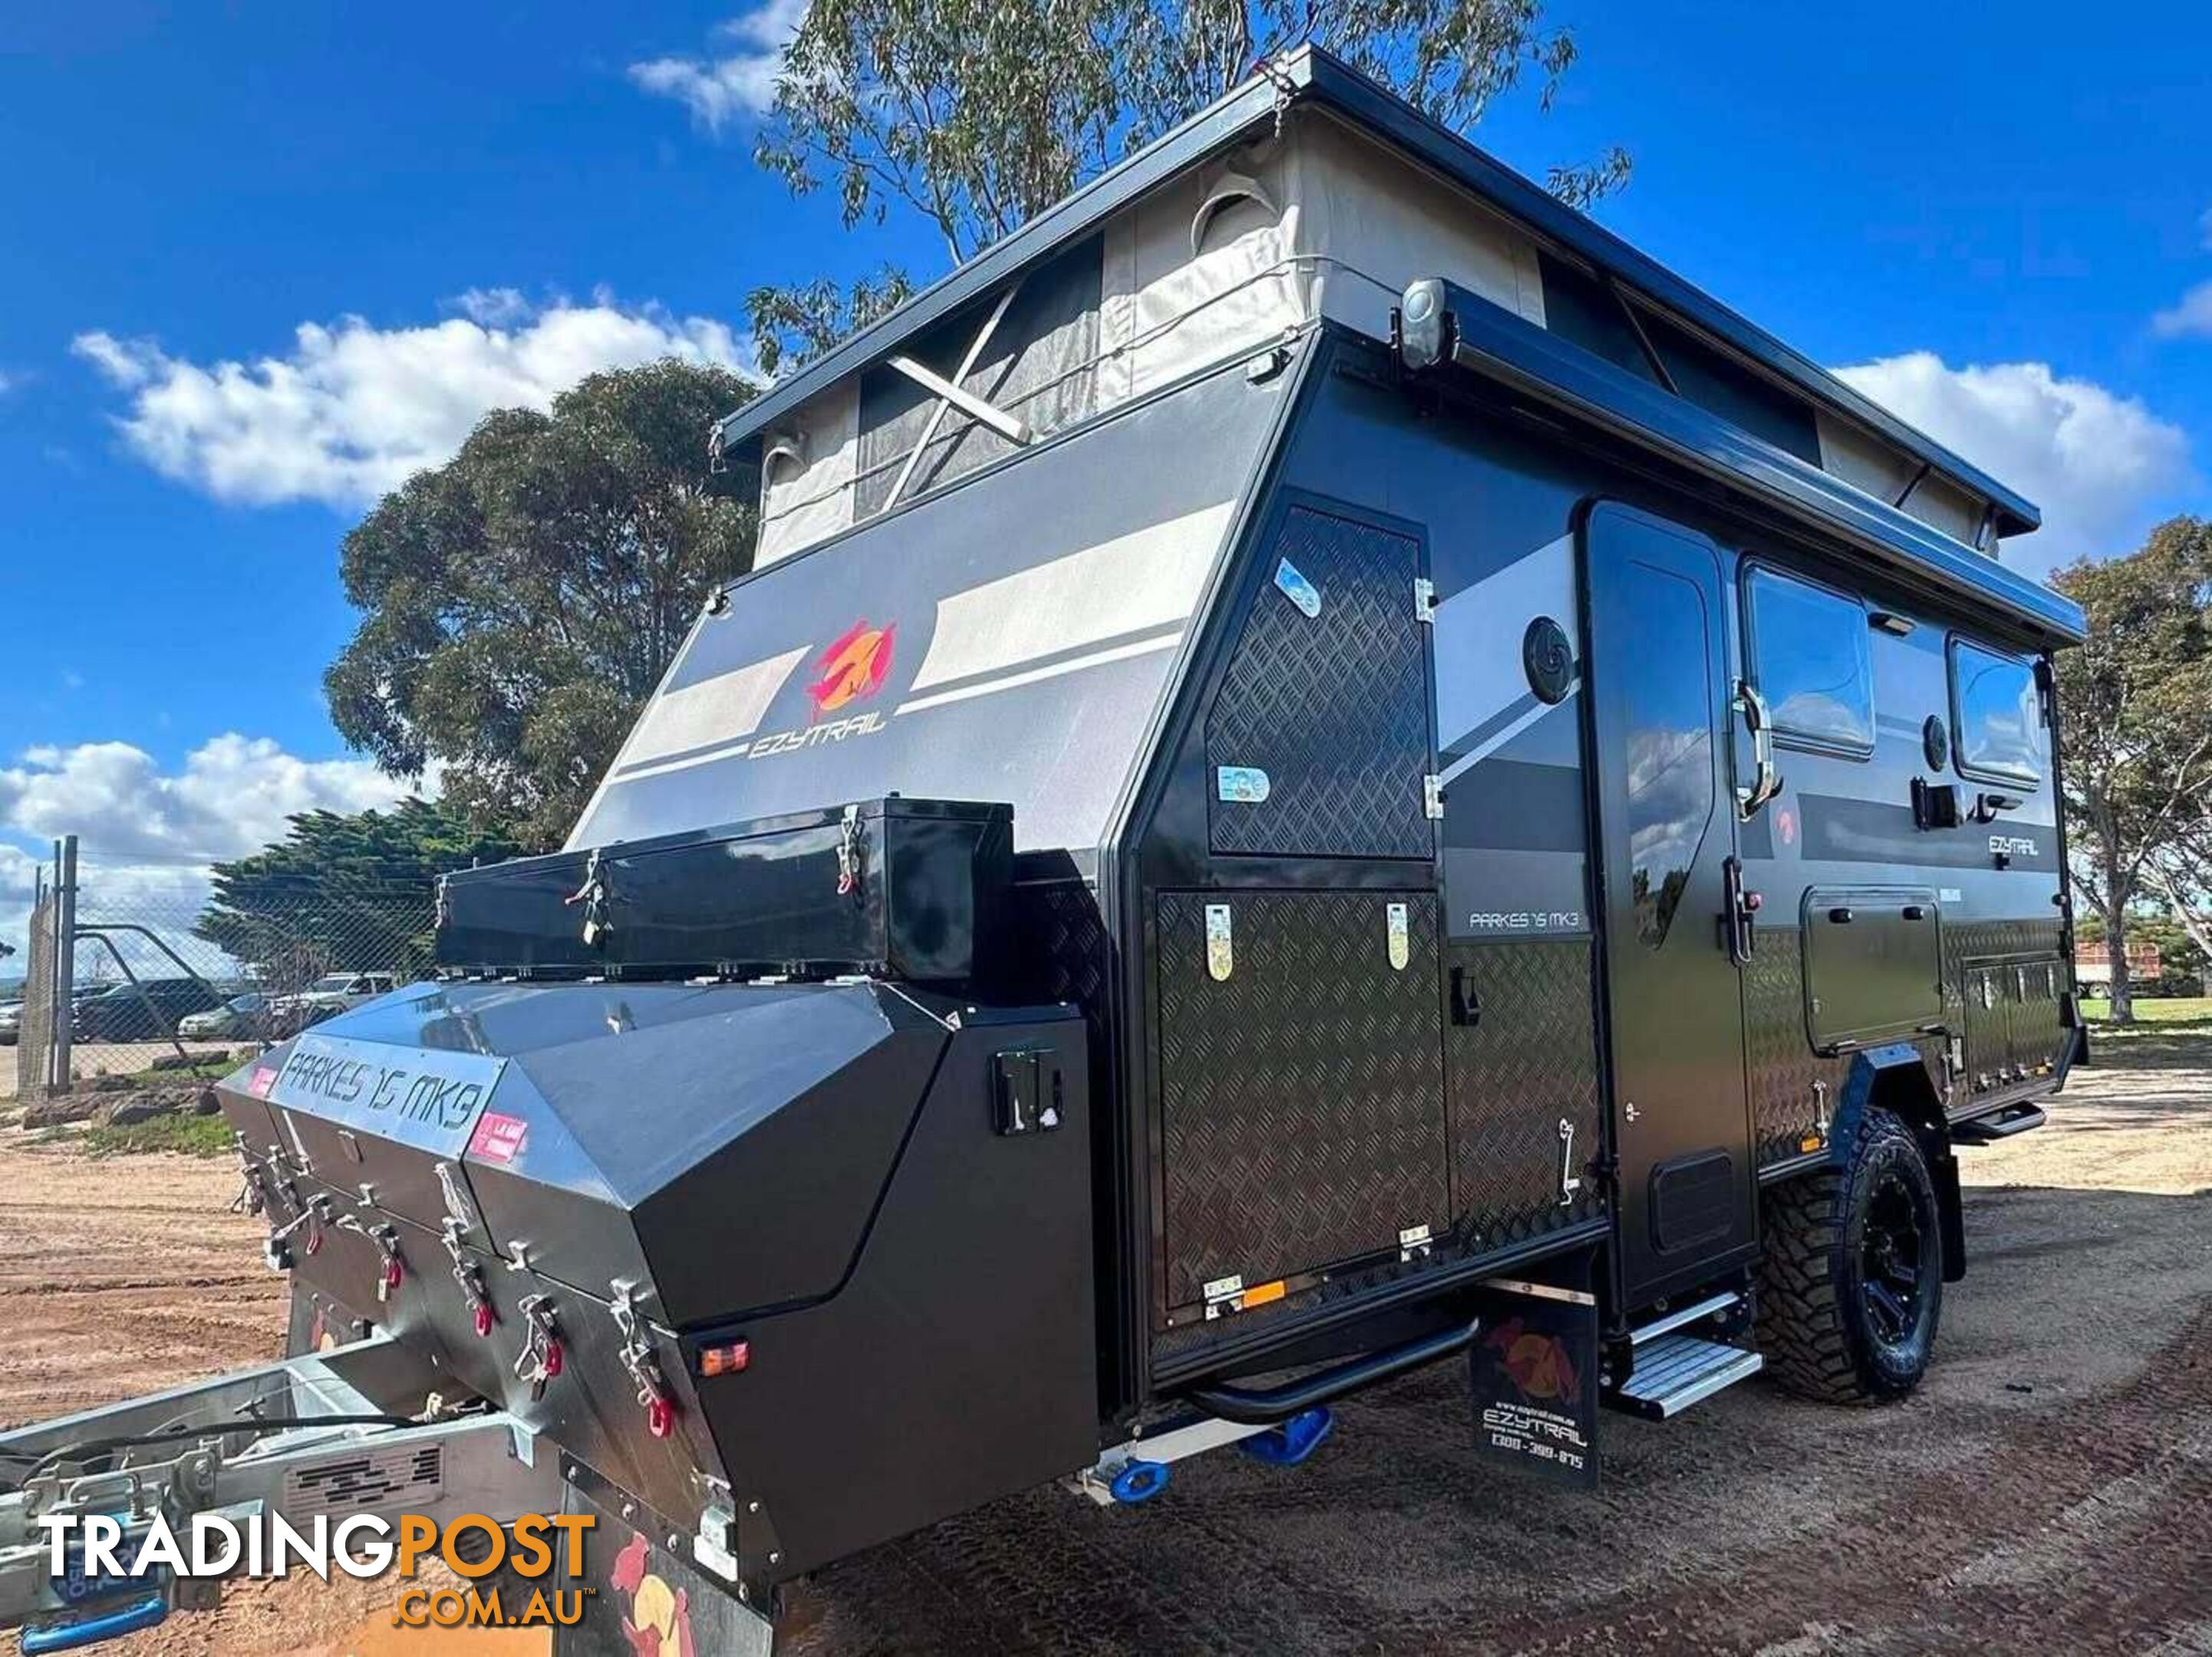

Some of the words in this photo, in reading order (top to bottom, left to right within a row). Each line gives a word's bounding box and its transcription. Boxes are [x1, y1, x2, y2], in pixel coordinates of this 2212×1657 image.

[748, 711, 887, 759] EZYTRAIL
[1469, 913, 1528, 928] PARKES
[1549, 912, 1578, 927] MK3
[280, 1053, 370, 1102] PARKES
[1483, 1408, 1587, 1448] EZYTRAIL
